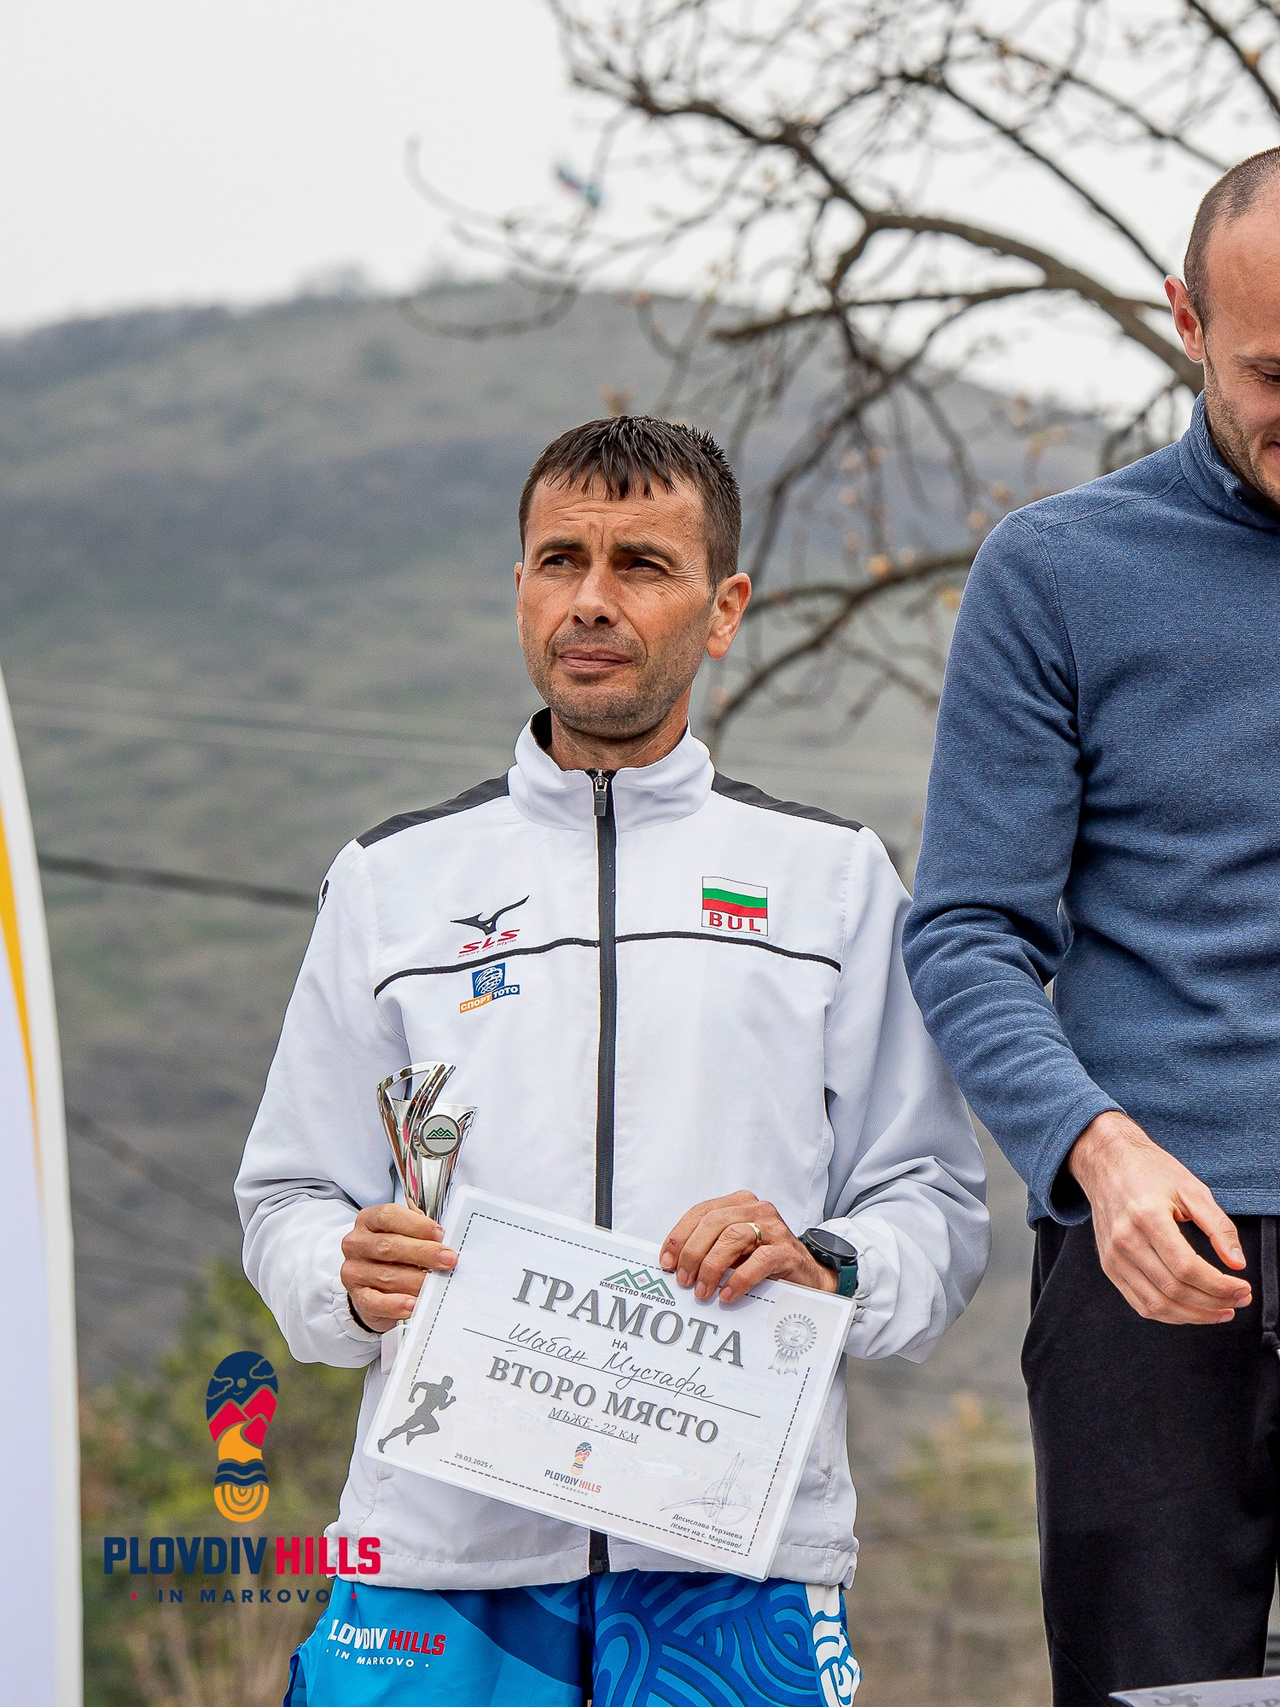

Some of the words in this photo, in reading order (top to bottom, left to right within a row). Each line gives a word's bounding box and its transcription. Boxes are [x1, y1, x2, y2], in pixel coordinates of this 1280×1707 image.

[709, 911, 761, 932] BUL
[459, 929, 520, 954] SLS
[460, 994, 491, 1011] СПОРТ
[493, 986, 519, 998] ТОТО
[599, 1280, 640, 1297] КМЕТСТВО
[640, 1292, 676, 1307] МАРКОВО
[512, 1268, 744, 1368] ГРАМОТА
[612, 1339, 628, 1351] НА
[486, 1356, 597, 1407] ВТОРО
[602, 1391, 719, 1444] МЯСТО
[548, 1407, 593, 1428] МЪЖЕ
[600, 1422, 617, 1435] 22
[454, 1452, 489, 1468] 29.03.2025
[544, 1469, 579, 1486] PLOVDIV
[578, 1480, 602, 1493] HILLS
[670, 1522, 691, 1534] /Кмет
[708, 1534, 742, 1548] Марково/
[672, 1513, 710, 1530] Десислава
[711, 1525, 743, 1540] Терзиева
[388, 1629, 446, 1656] HILLS
[335, 1649, 350, 1660] IN
[356, 1656, 414, 1667] MARKOVO
